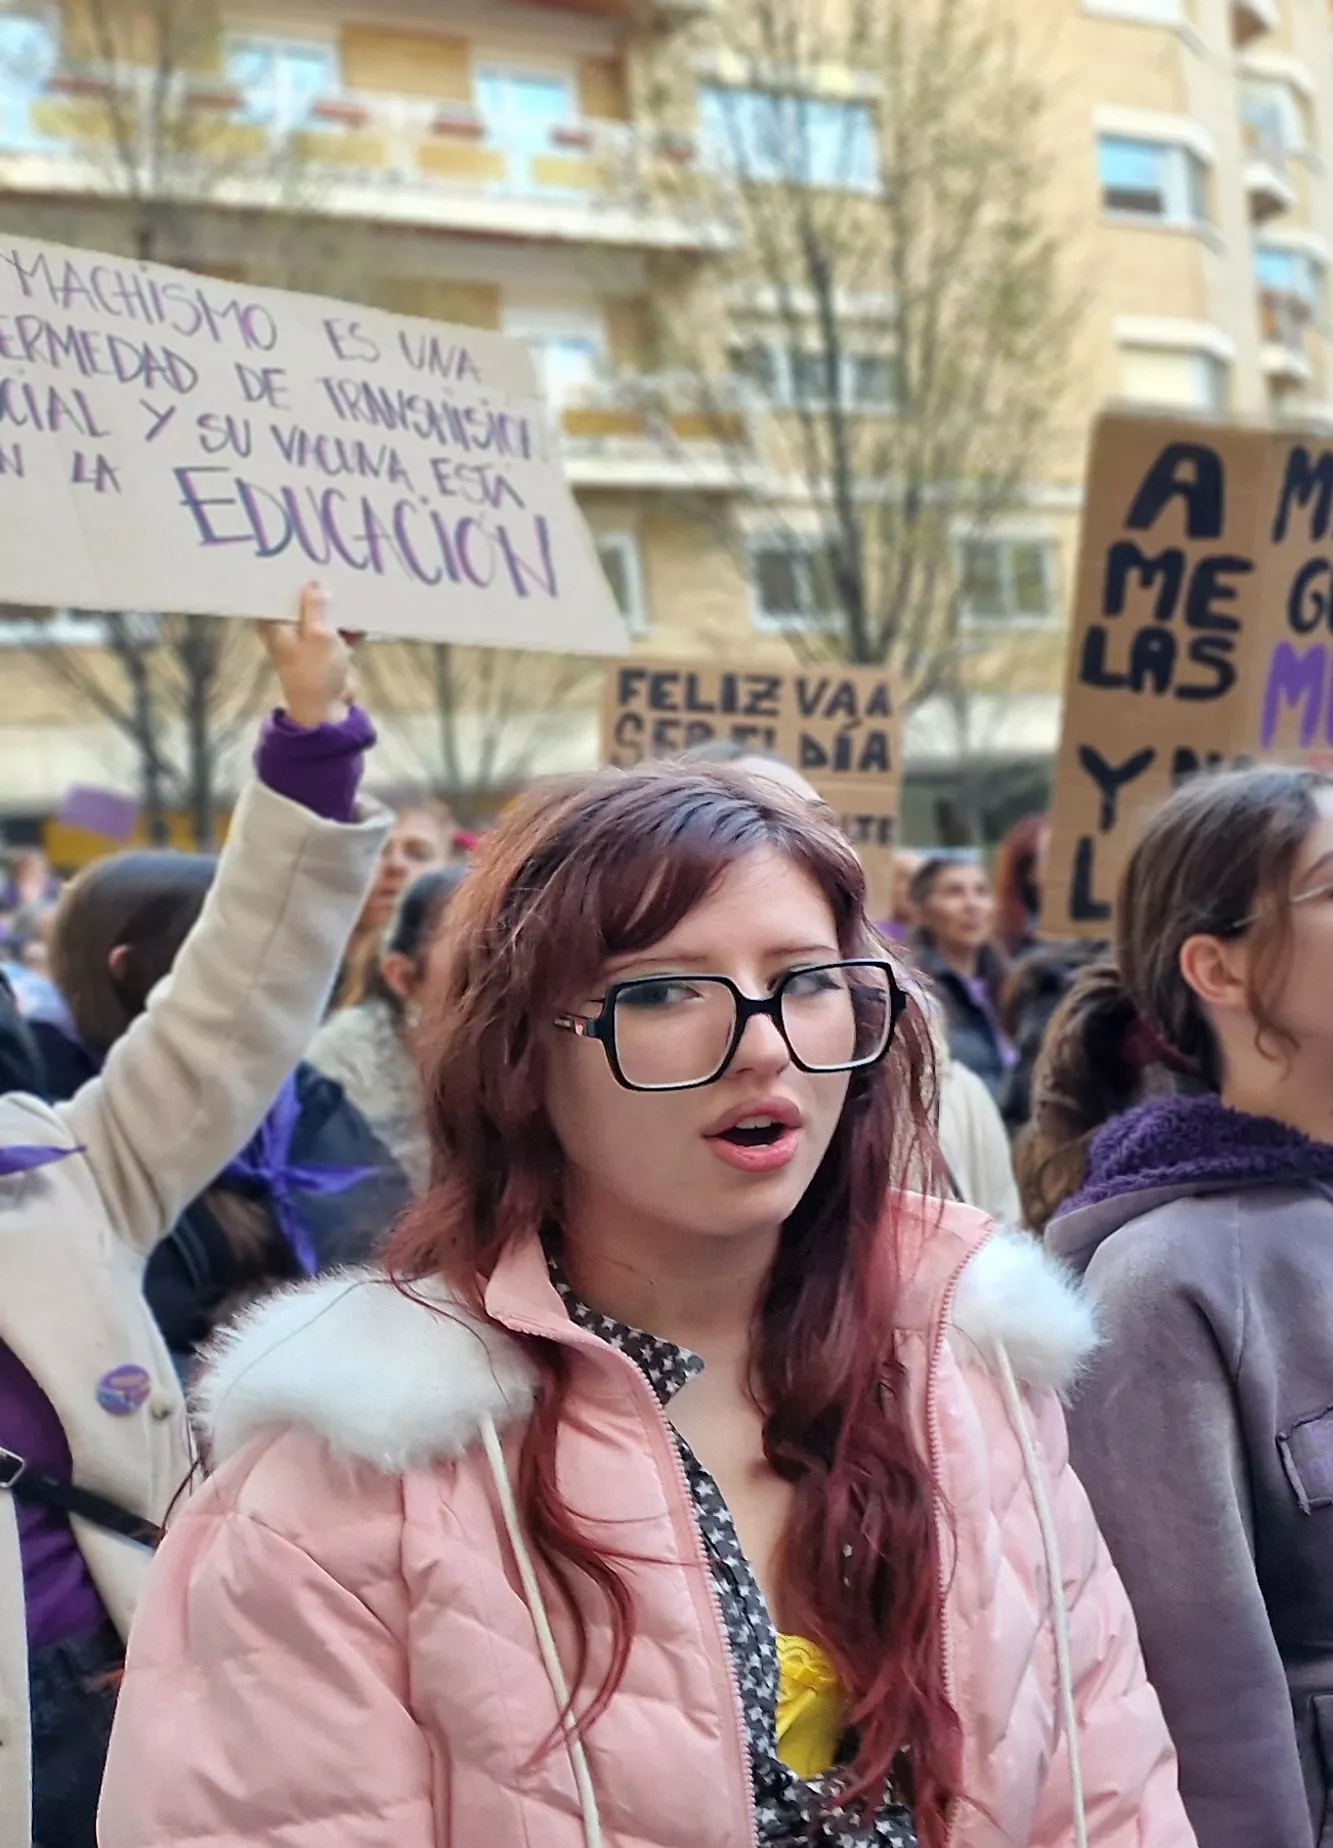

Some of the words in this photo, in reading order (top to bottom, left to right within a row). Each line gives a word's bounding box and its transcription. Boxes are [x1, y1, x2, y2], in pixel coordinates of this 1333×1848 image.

[234, 361, 291, 411] DE
[322, 318, 381, 364] ES
[399, 329, 482, 384] UNA
[71, 450, 122, 494] LA
[139, 397, 176, 442] Y
[196, 411, 252, 459] SU
[270, 422, 416, 495] VACUNA
[1122, 442, 1225, 540] A
[1103, 541, 1255, 634] ME
[617, 666, 782, 718] FELIZ
[1078, 625, 1237, 701] LAS
[798, 714, 892, 773] DÍA
[1076, 744, 1156, 833] Y
